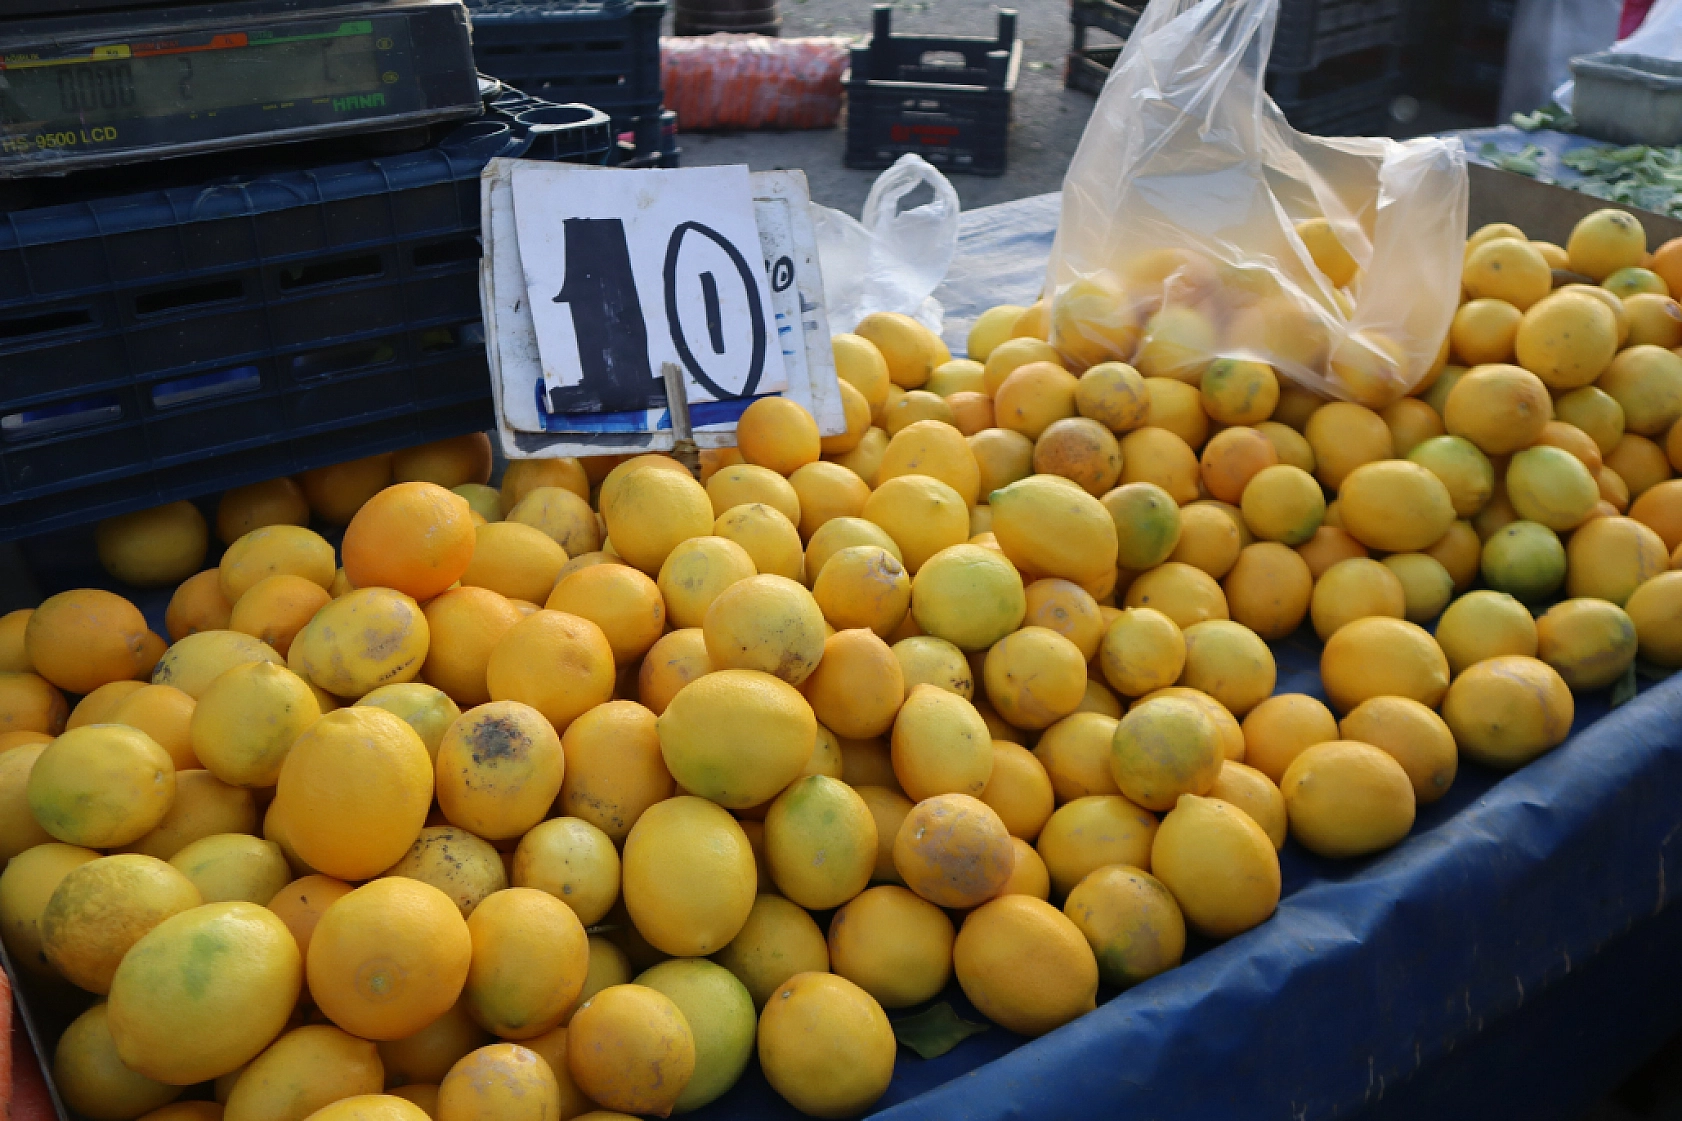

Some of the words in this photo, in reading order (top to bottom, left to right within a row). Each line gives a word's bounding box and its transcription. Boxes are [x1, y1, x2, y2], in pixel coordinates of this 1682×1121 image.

[332, 93, 386, 112] HANA
[79, 126, 118, 144] LCD
[551, 216, 766, 413] 10
